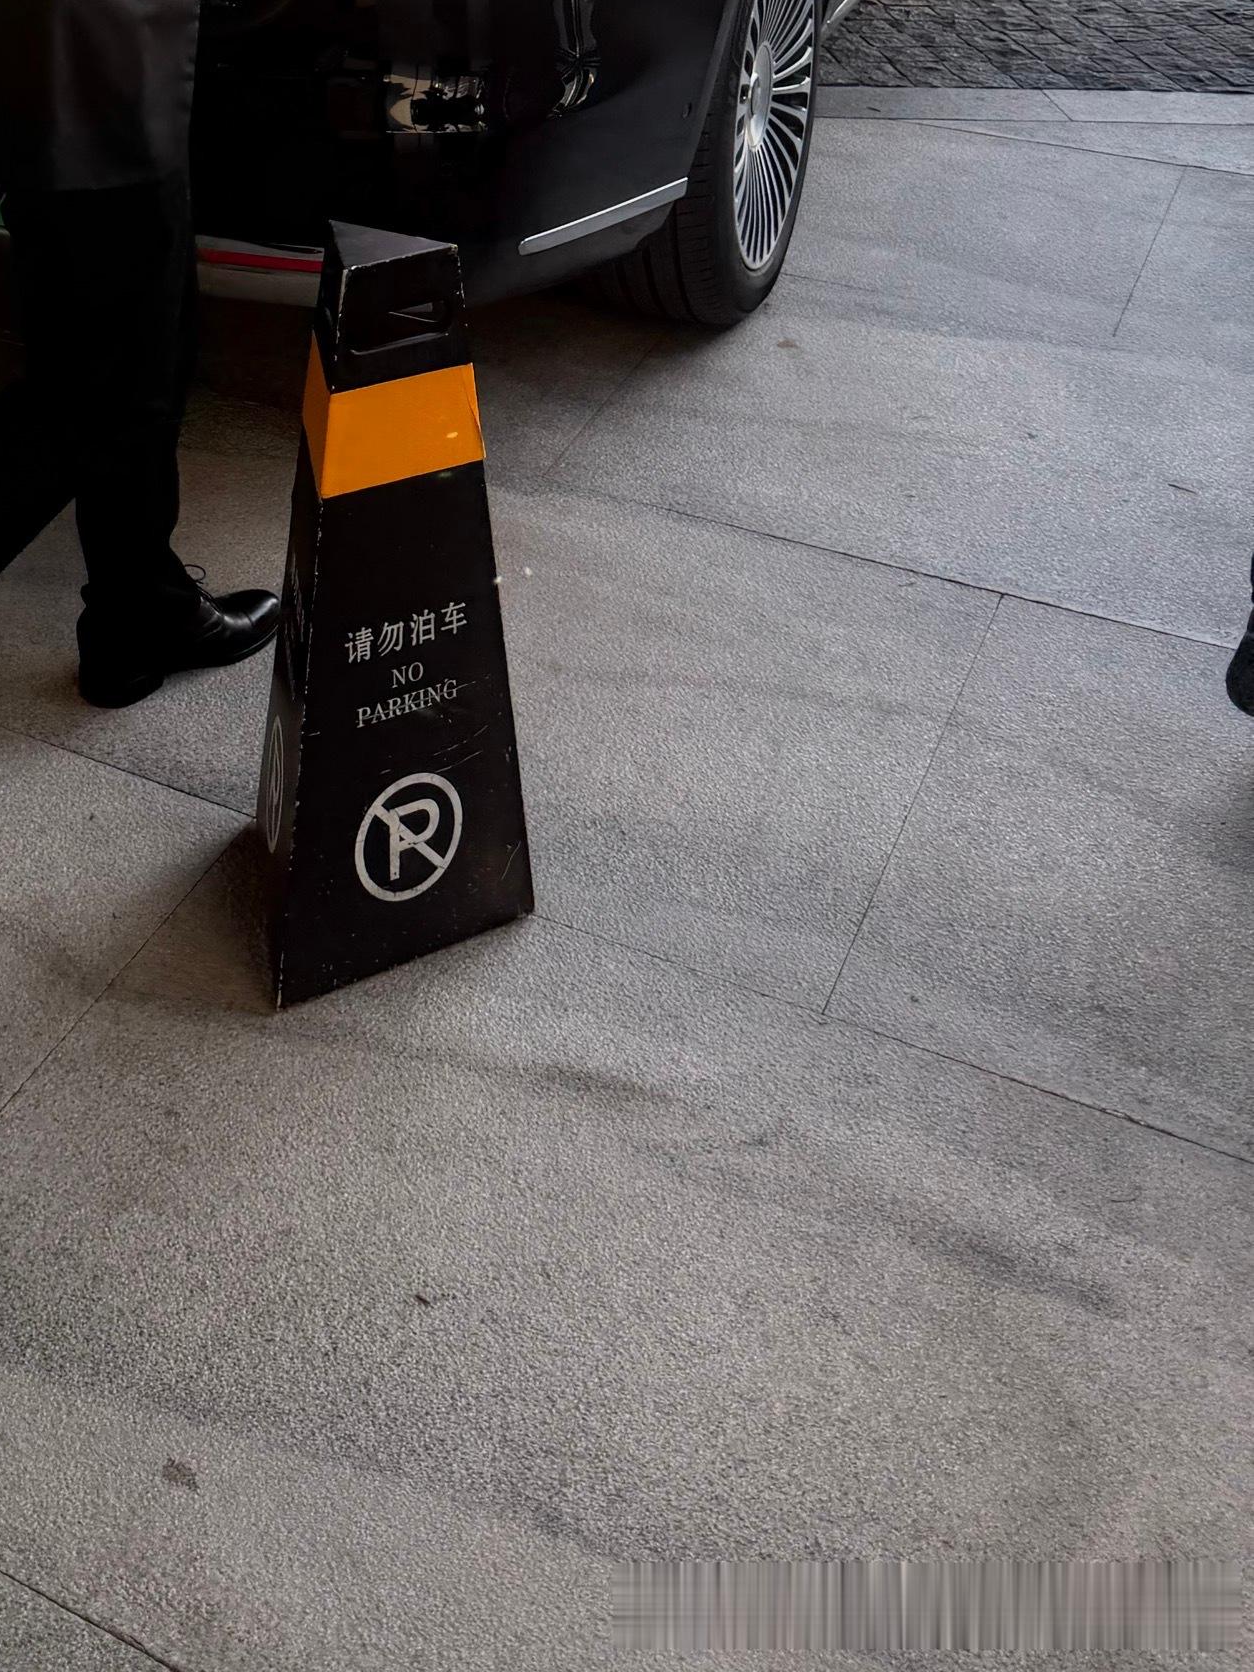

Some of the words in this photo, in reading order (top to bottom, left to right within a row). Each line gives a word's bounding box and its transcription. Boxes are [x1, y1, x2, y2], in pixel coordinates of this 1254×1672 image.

[345, 601, 468, 664] 请勿泊车
[391, 661, 424, 689] NO
[356, 679, 459, 728] PARKING
